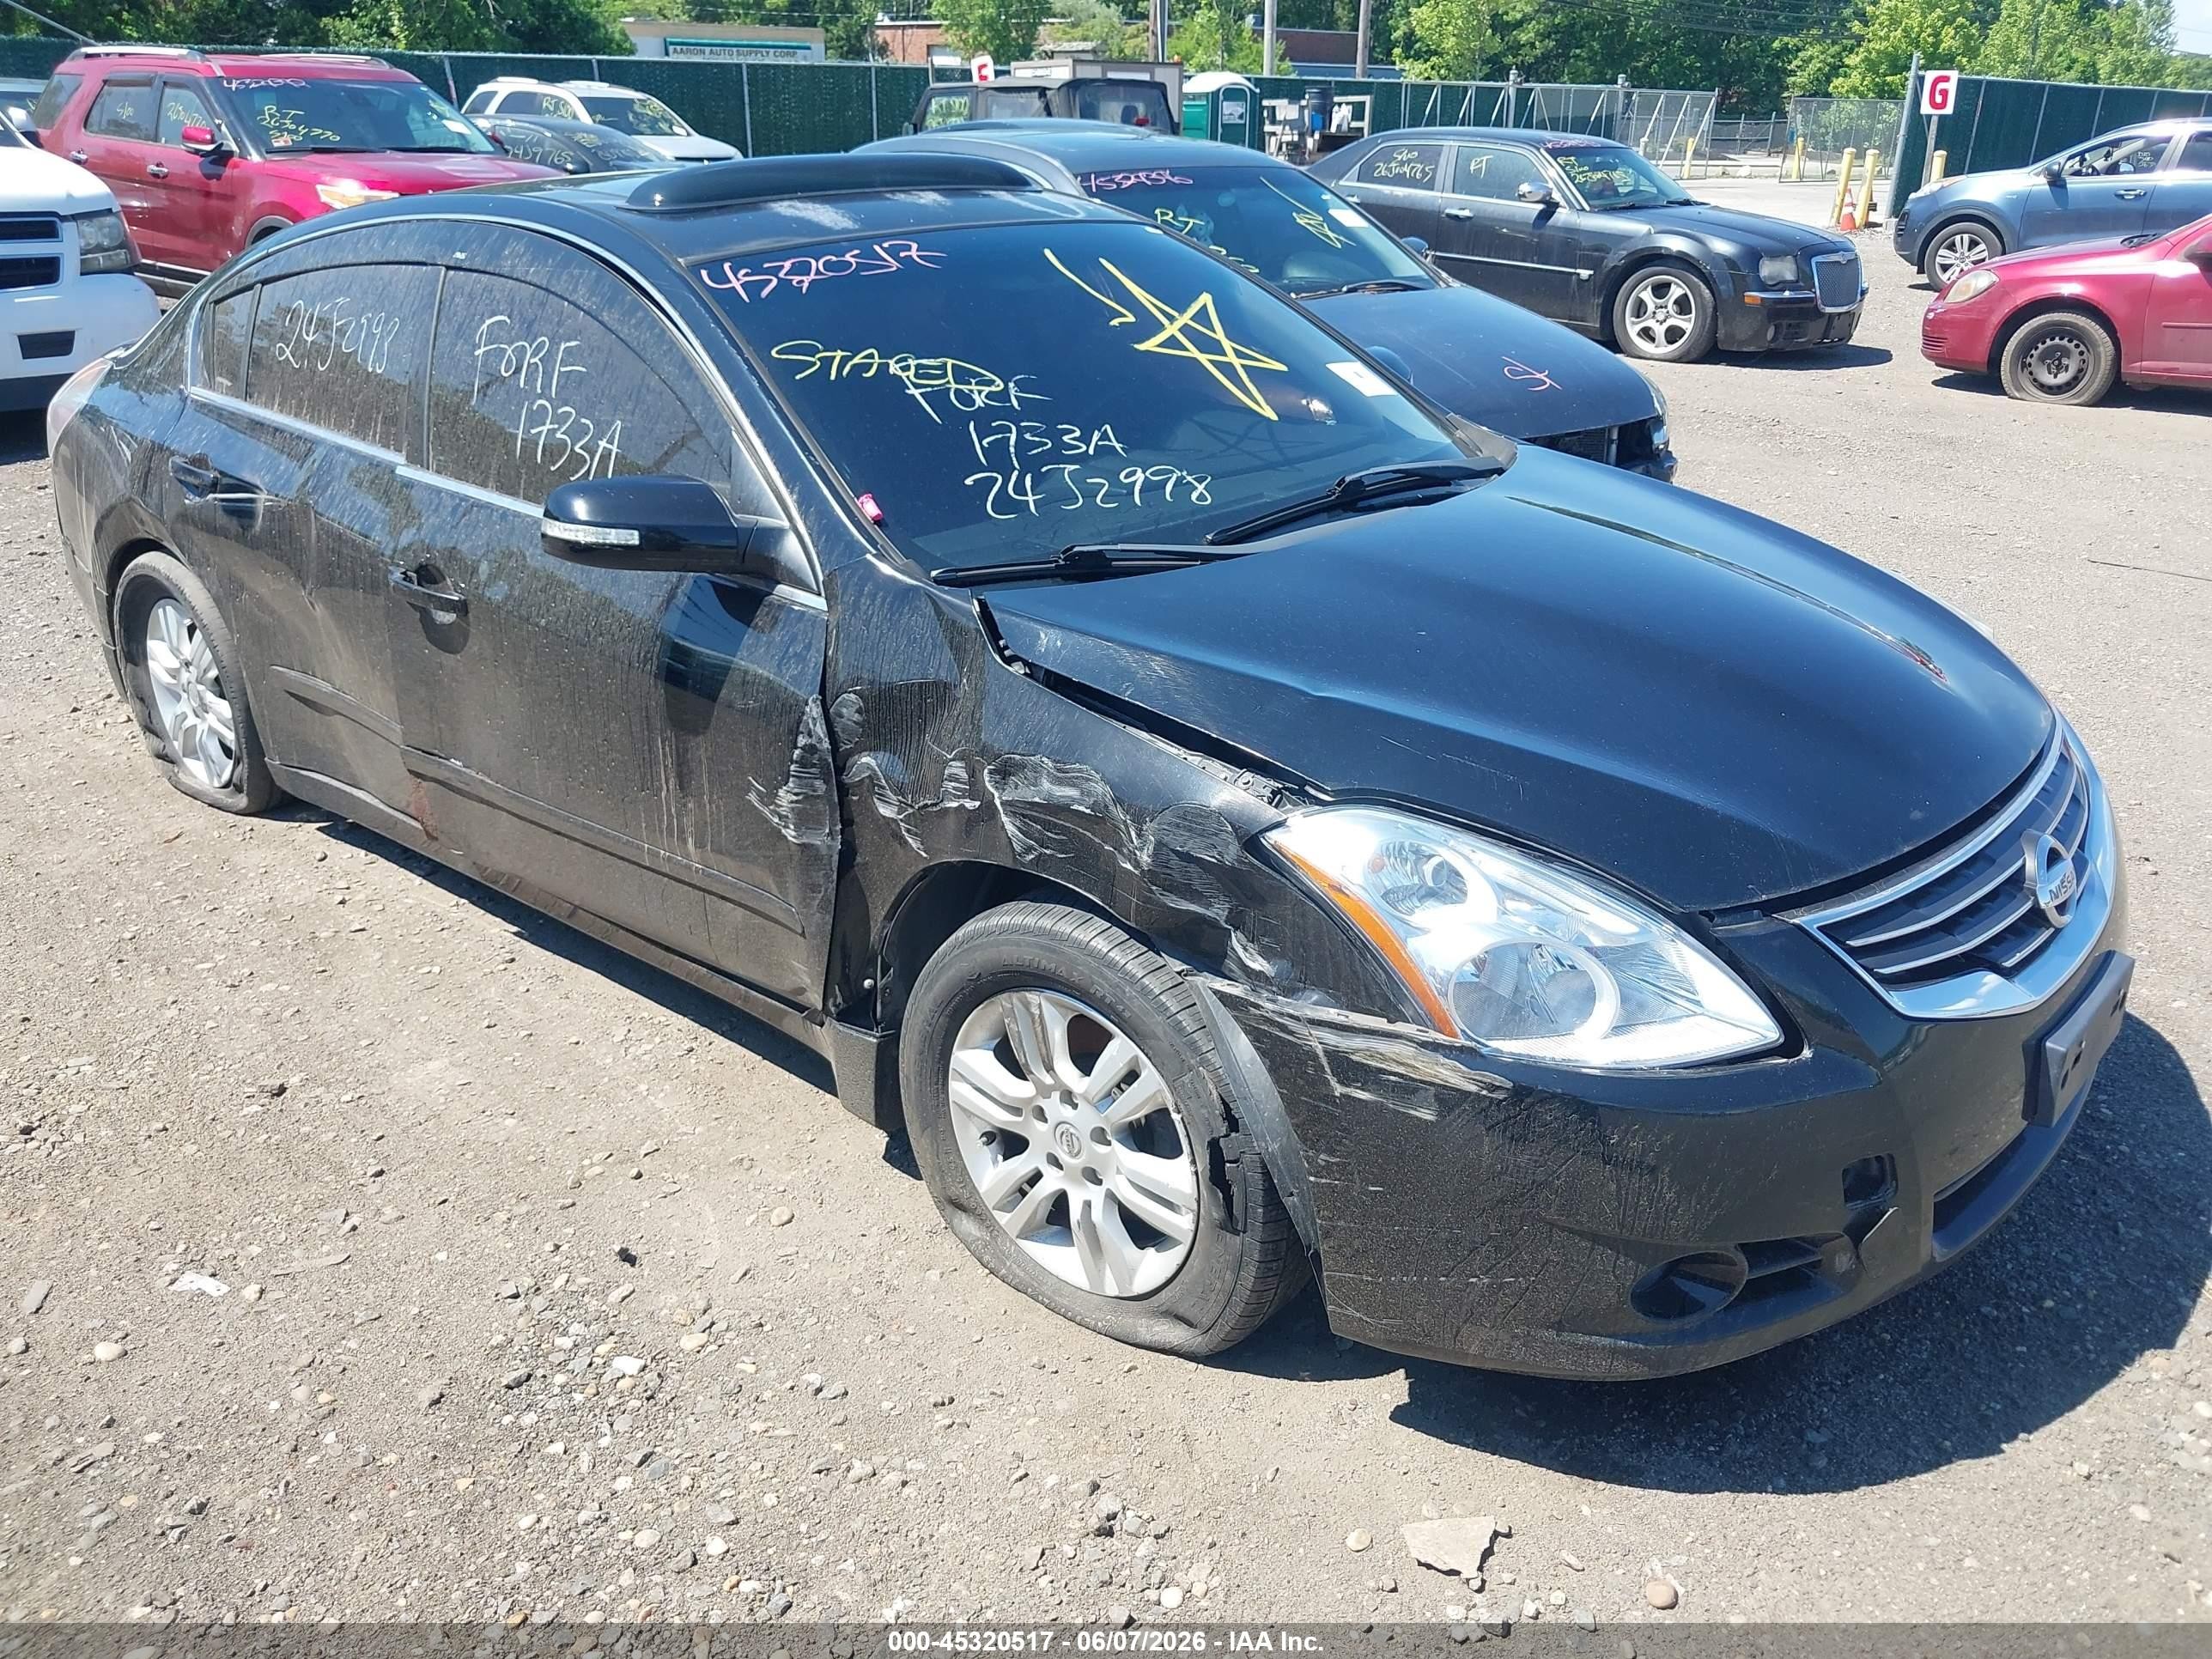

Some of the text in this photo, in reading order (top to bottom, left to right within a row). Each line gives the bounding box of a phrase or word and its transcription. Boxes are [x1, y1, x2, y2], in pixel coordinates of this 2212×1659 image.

[672, 47, 706, 56] AARON
[709, 48, 734, 57] AUTO
[736, 49, 770, 58] SUPPLY
[1929, 75, 1951, 110] G
[516, 399, 623, 481] 1733A
[969, 420, 1129, 471] 1733A
[963, 464, 1212, 519] 24J2998
